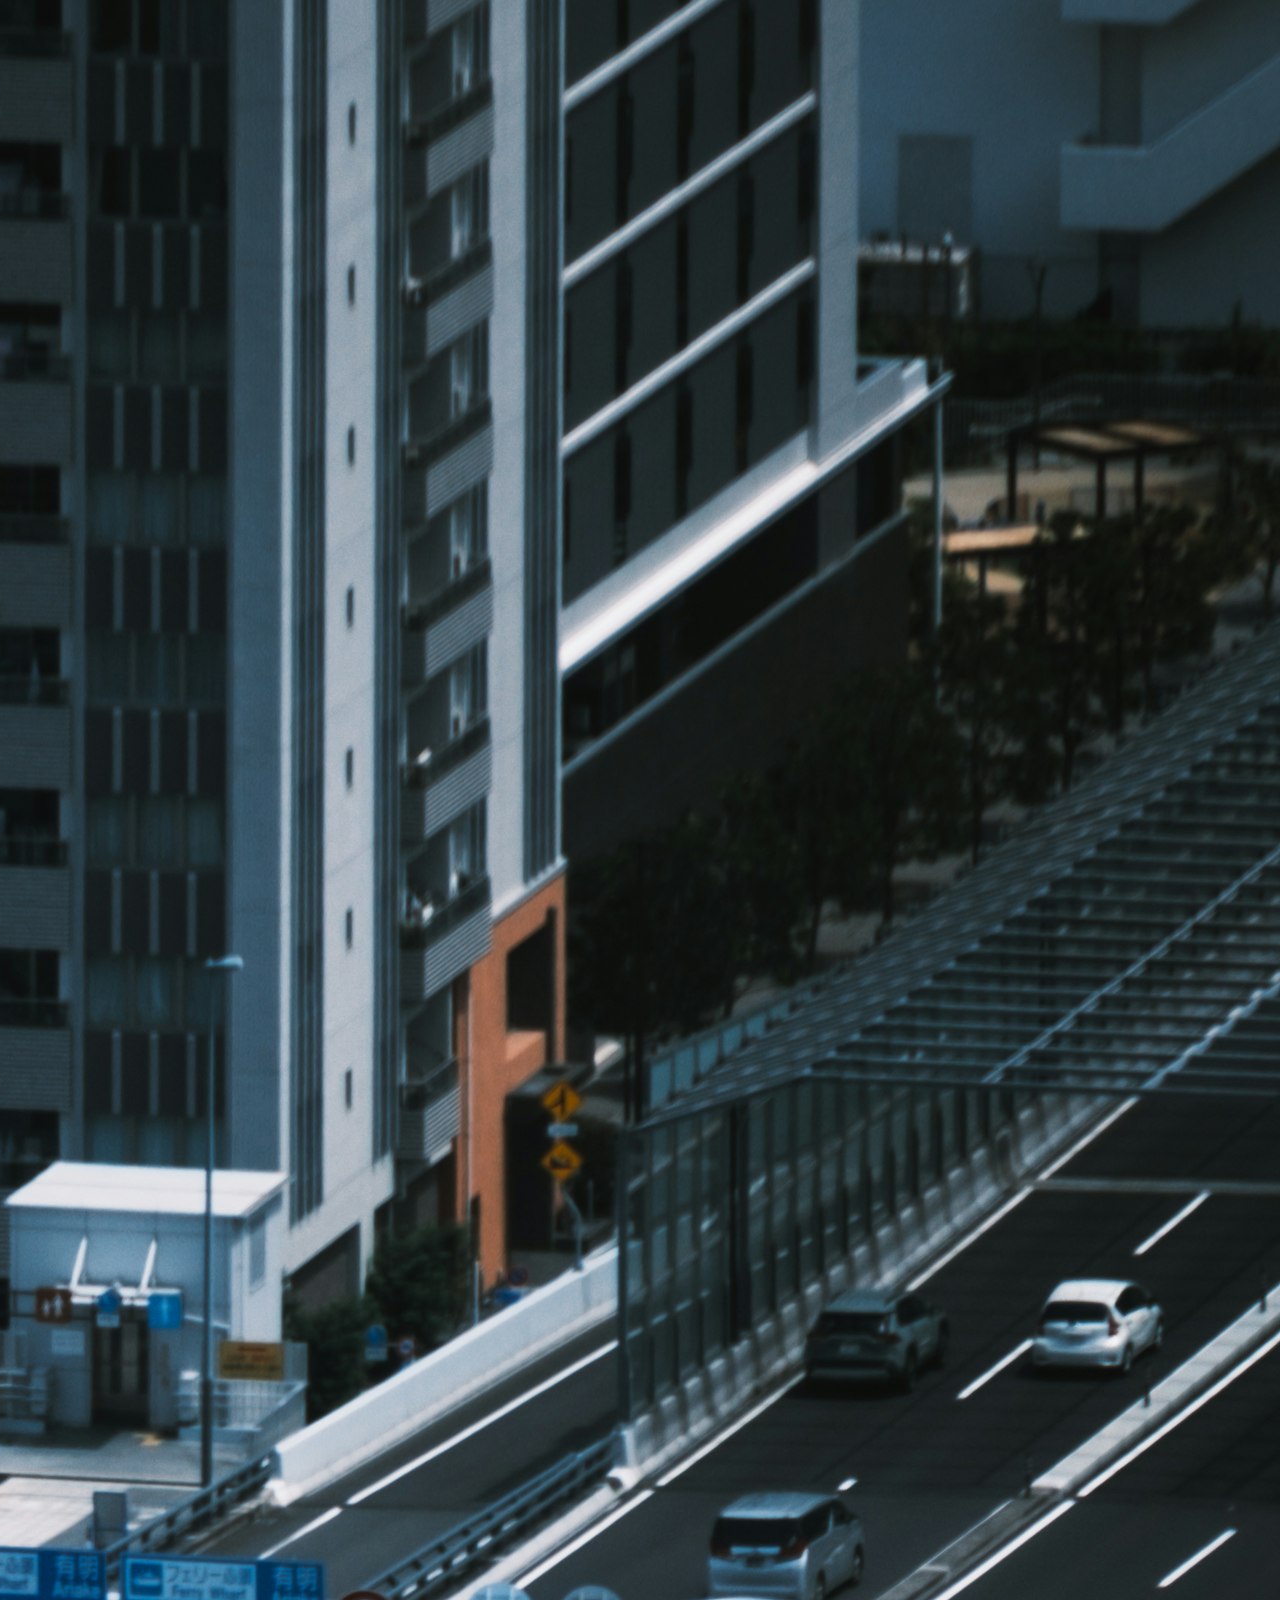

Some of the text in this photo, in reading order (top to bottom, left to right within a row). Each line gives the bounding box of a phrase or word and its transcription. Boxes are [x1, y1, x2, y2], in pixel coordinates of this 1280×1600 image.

[55, 1554, 100, 1580] 有明
[273, 1565, 318, 1592] 有明
[51, 1579, 102, 1599] Ariake
[171, 1585, 247, 1600] Ferry Wharf
